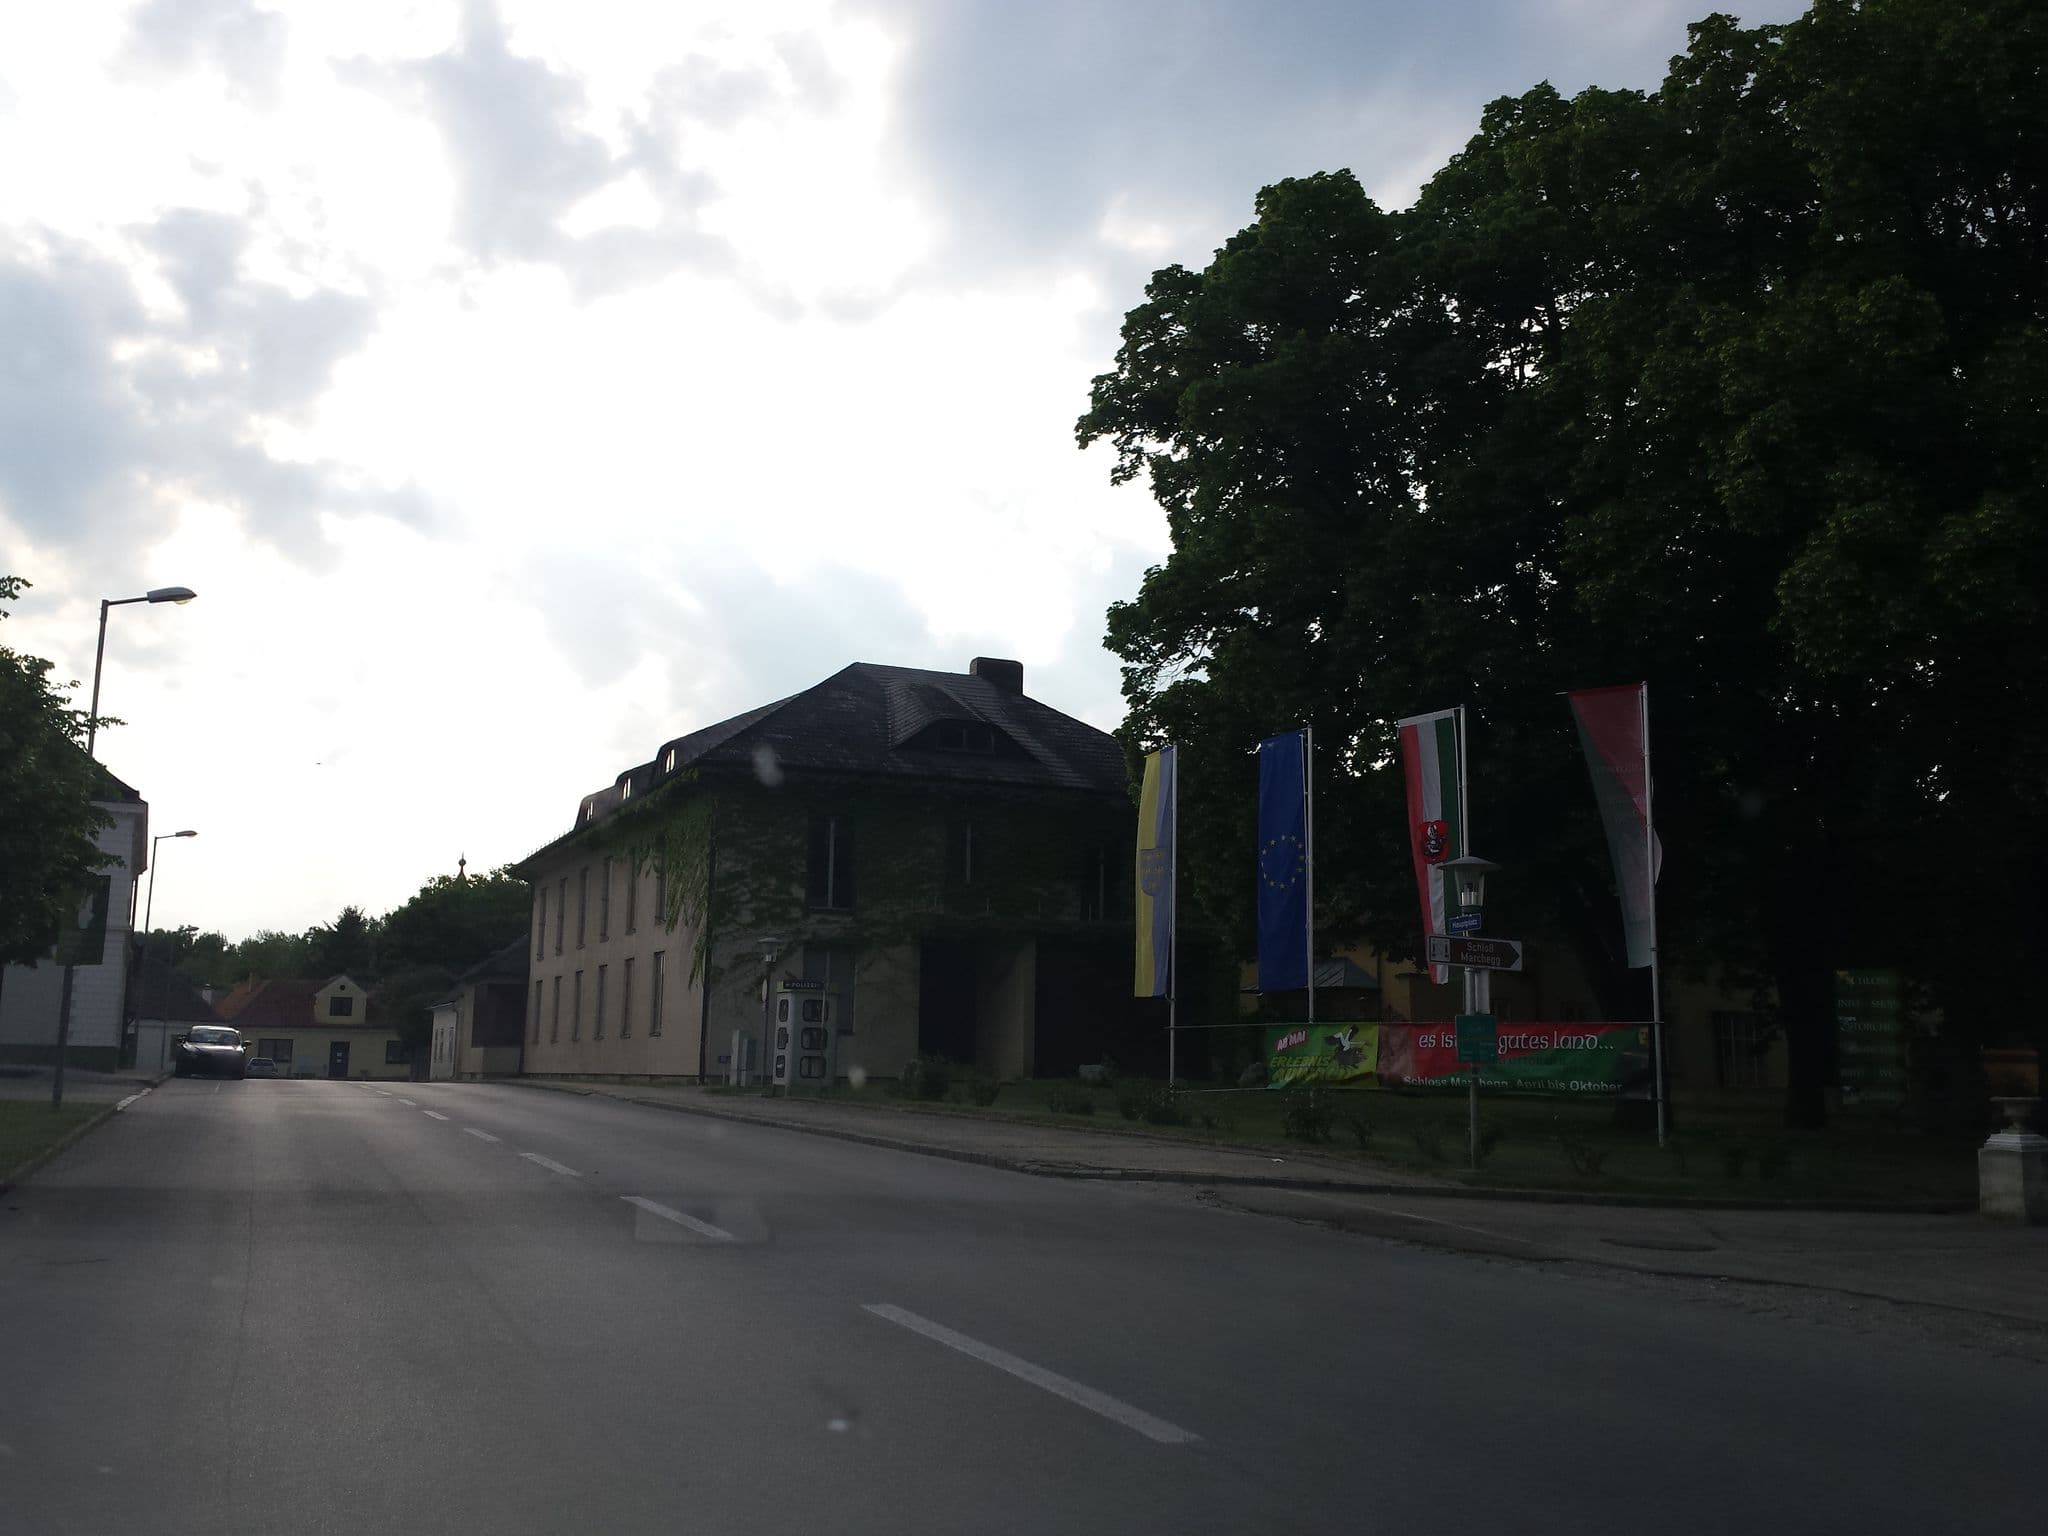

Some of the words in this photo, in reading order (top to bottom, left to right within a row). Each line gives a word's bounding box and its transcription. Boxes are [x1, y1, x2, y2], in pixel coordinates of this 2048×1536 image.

[1461, 951, 1501, 966] Marchegg
[1289, 1029, 1306, 1047] MAI
[1419, 1034, 1436, 1048] es
[1498, 1033, 1549, 1055] gutes
[1403, 1075, 1448, 1087] Schloss
[1548, 1079, 1566, 1089] bis
[1570, 1080, 1624, 1091] Oktober
